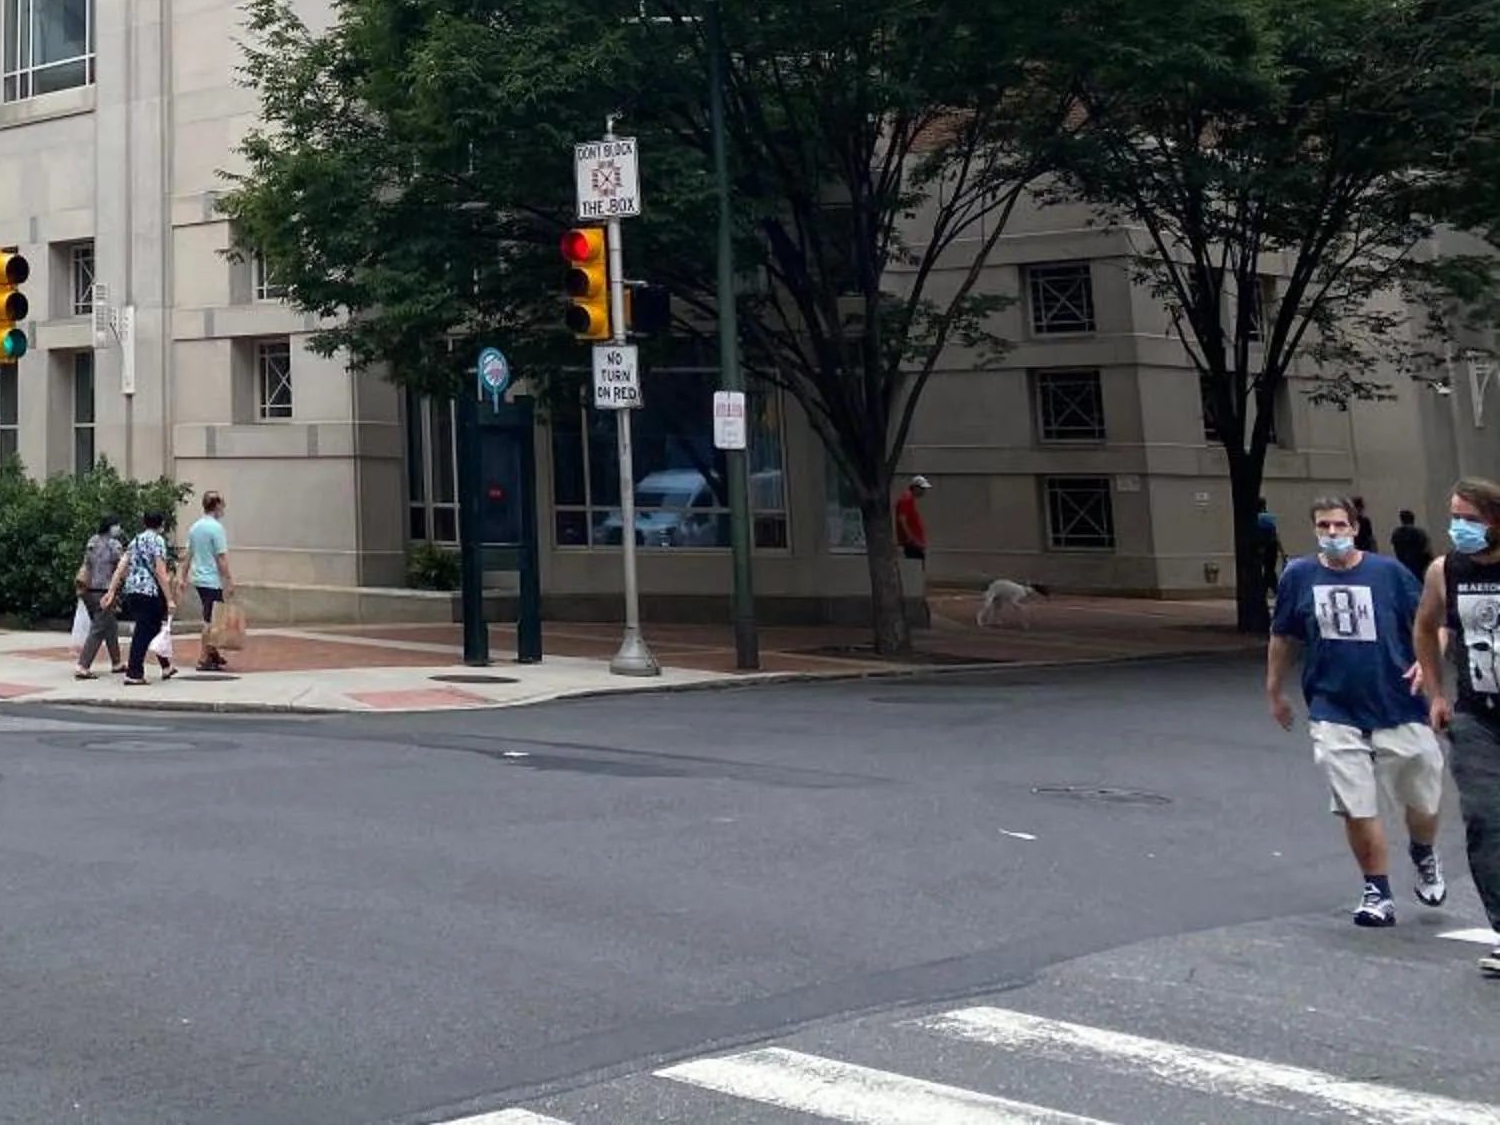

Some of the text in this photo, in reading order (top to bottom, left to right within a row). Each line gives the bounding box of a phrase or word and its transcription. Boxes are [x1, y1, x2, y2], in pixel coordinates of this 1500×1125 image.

[582, 197, 635, 215] THE BOX
[607, 351, 623, 365] NO
[601, 369, 631, 382] TURN
[597, 386, 637, 400] ON RED
